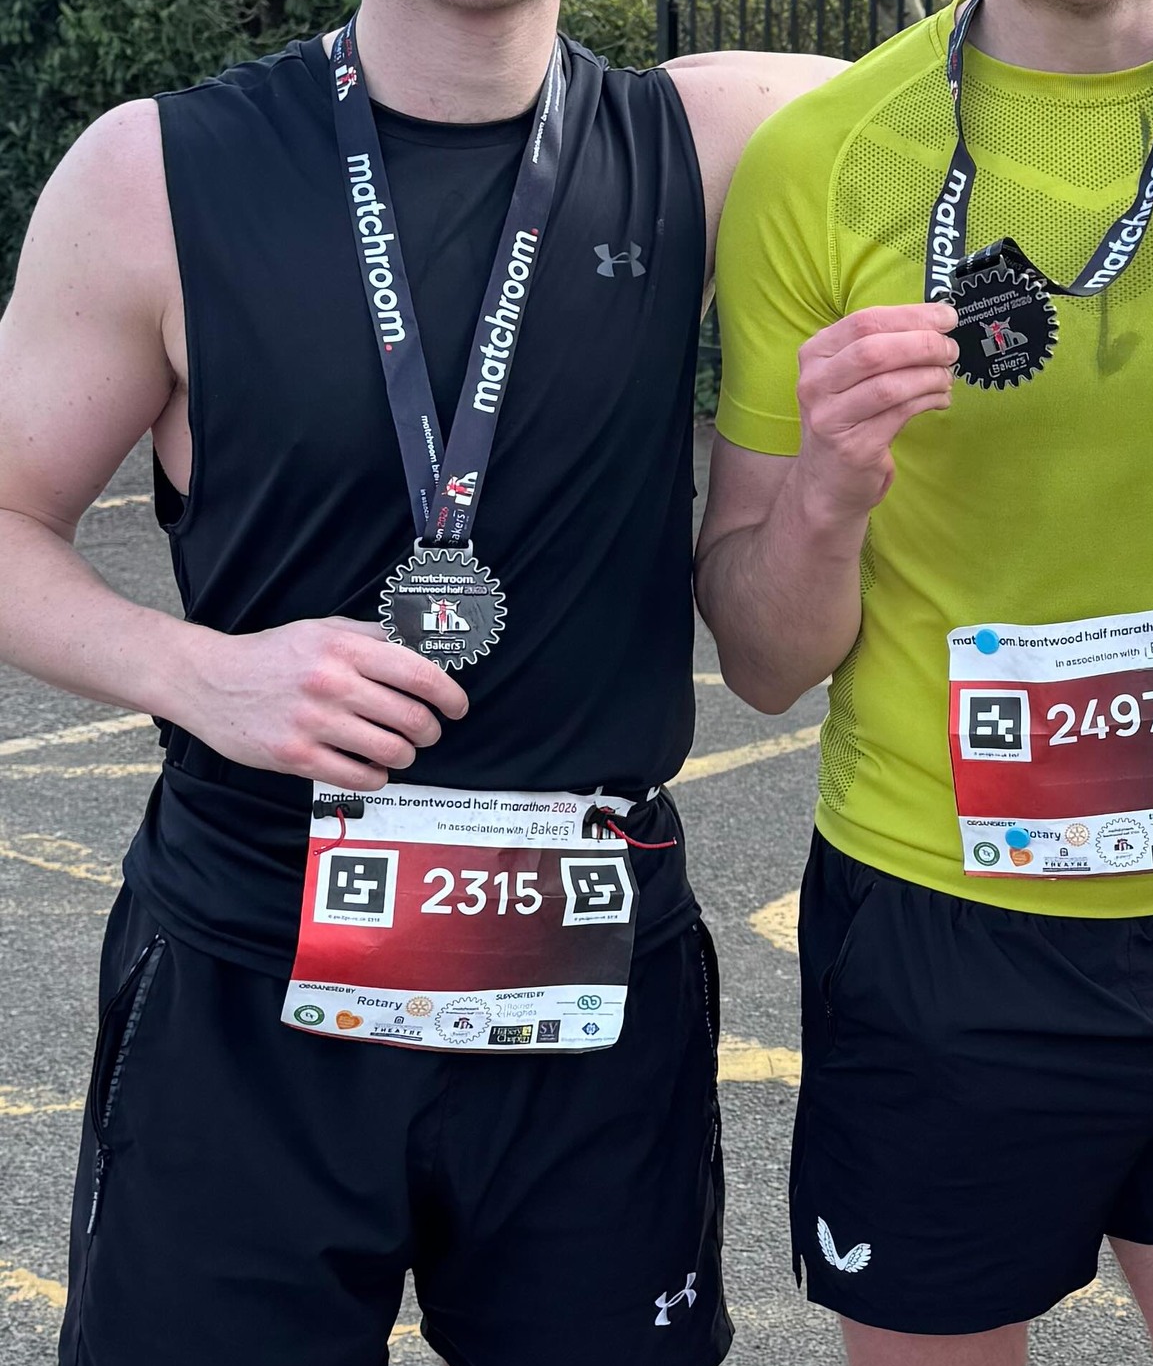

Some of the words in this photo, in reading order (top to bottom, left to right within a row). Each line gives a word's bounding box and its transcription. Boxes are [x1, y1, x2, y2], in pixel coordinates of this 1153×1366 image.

[425, 640, 461, 650] Bakers
[1018, 631, 1083, 648] brentwood
[1084, 627, 1108, 642] half
[1065, 649, 1119, 667] association
[1119, 647, 1140, 658] with
[399, 795, 472, 810] brentwood
[473, 797, 499, 811] half
[500, 801, 550, 813] marathon
[551, 802, 578, 813] 2026
[448, 822, 505, 834] association
[530, 821, 570, 836] Bakers
[1024, 828, 1062, 842] otary
[420, 867, 544, 916] 2315
[357, 995, 403, 1011] Rotary
